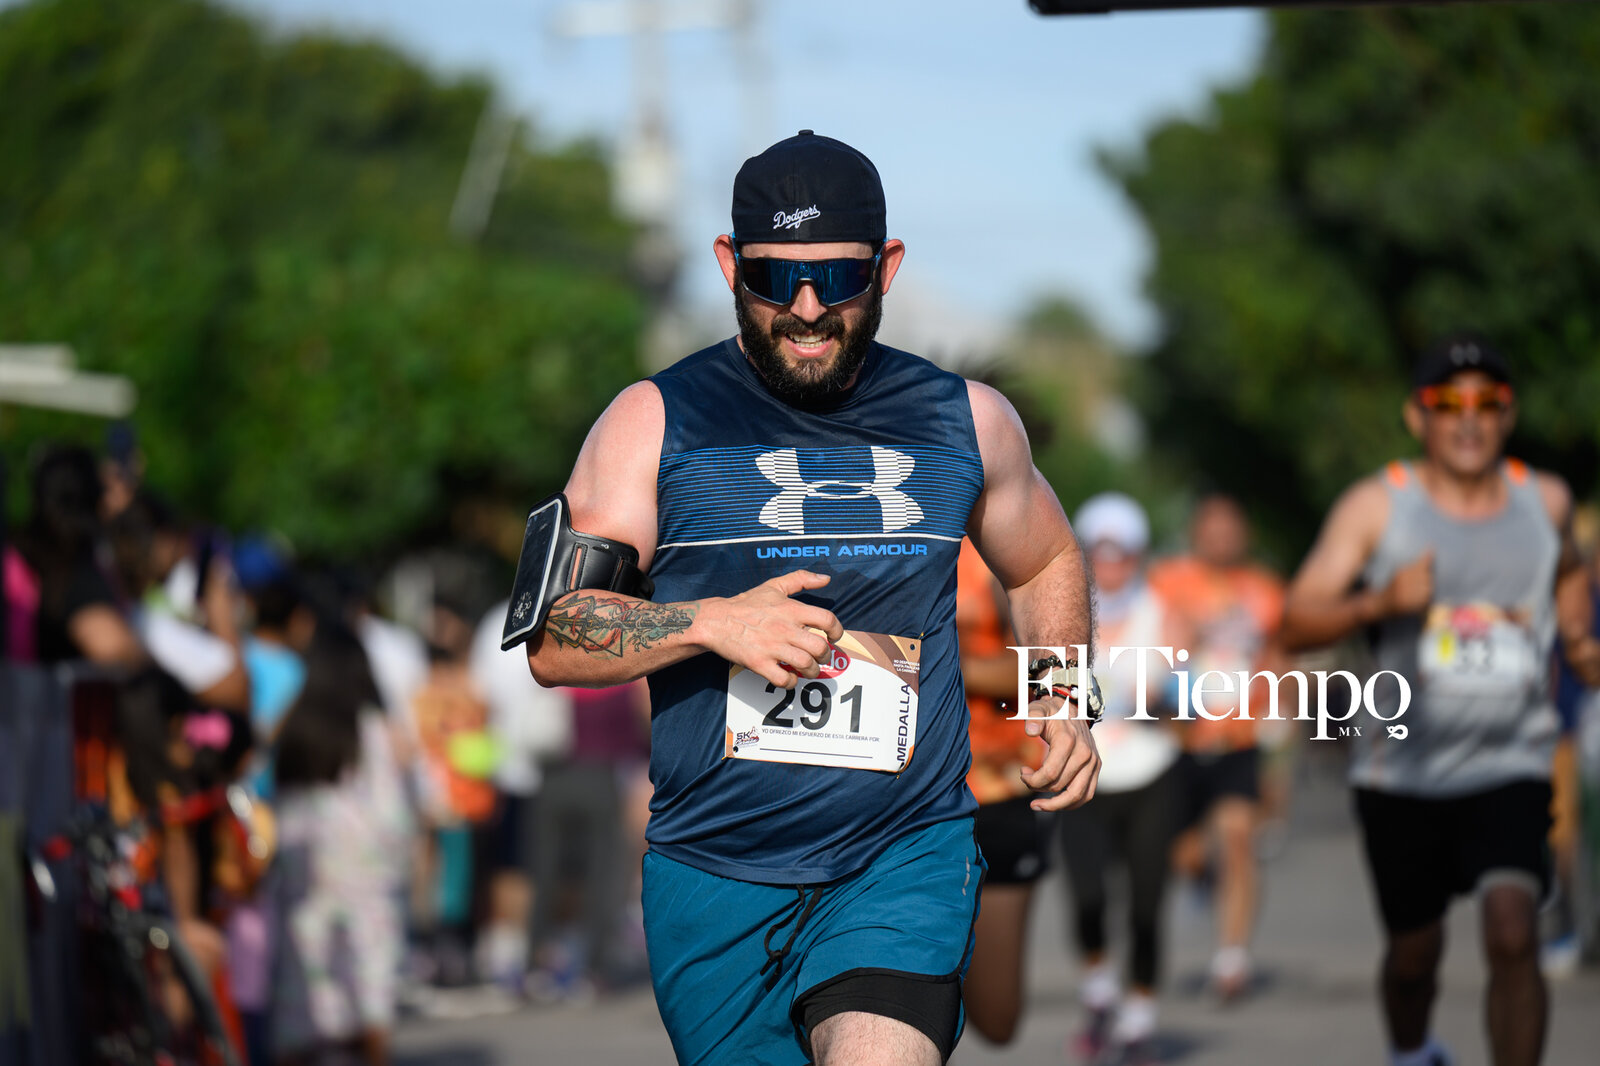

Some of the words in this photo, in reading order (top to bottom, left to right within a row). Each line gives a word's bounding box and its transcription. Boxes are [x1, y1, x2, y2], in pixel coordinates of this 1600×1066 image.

[773, 204, 821, 229] Dodgers
[756, 545, 830, 559] UNDER
[837, 544, 928, 557] ARMOUR
[761, 681, 863, 733] 291
[896, 683, 911, 762] MEDALLA
